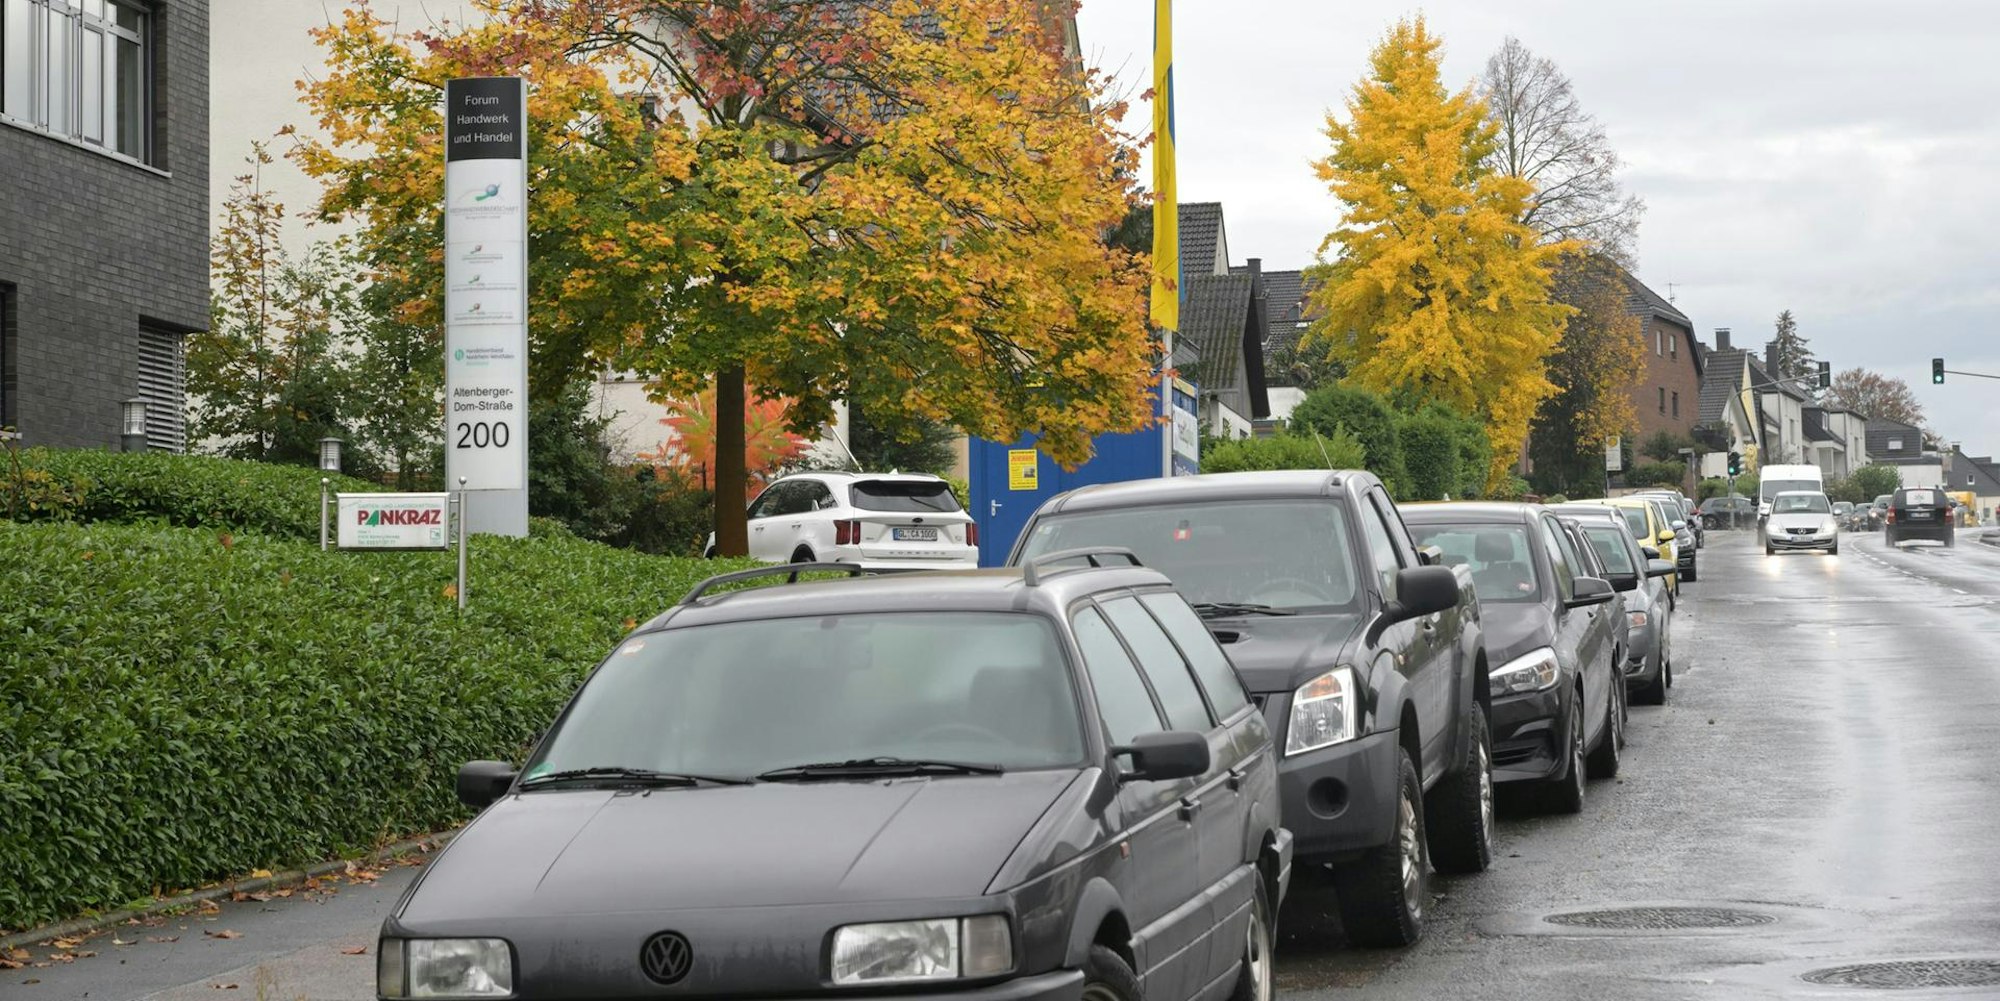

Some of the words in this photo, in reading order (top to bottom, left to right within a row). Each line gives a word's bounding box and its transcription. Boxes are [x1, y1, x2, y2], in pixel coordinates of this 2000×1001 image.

[465, 95, 499, 106] Forum
[457, 114, 509, 124] Handwerk
[454, 133, 471, 143] und
[474, 131, 513, 143] Handel
[453, 387, 513, 399] Altenberger-
[454, 400, 514, 412] Dom-Straße
[457, 421, 510, 449] 200
[358, 509, 441, 527] PANKRAZ
